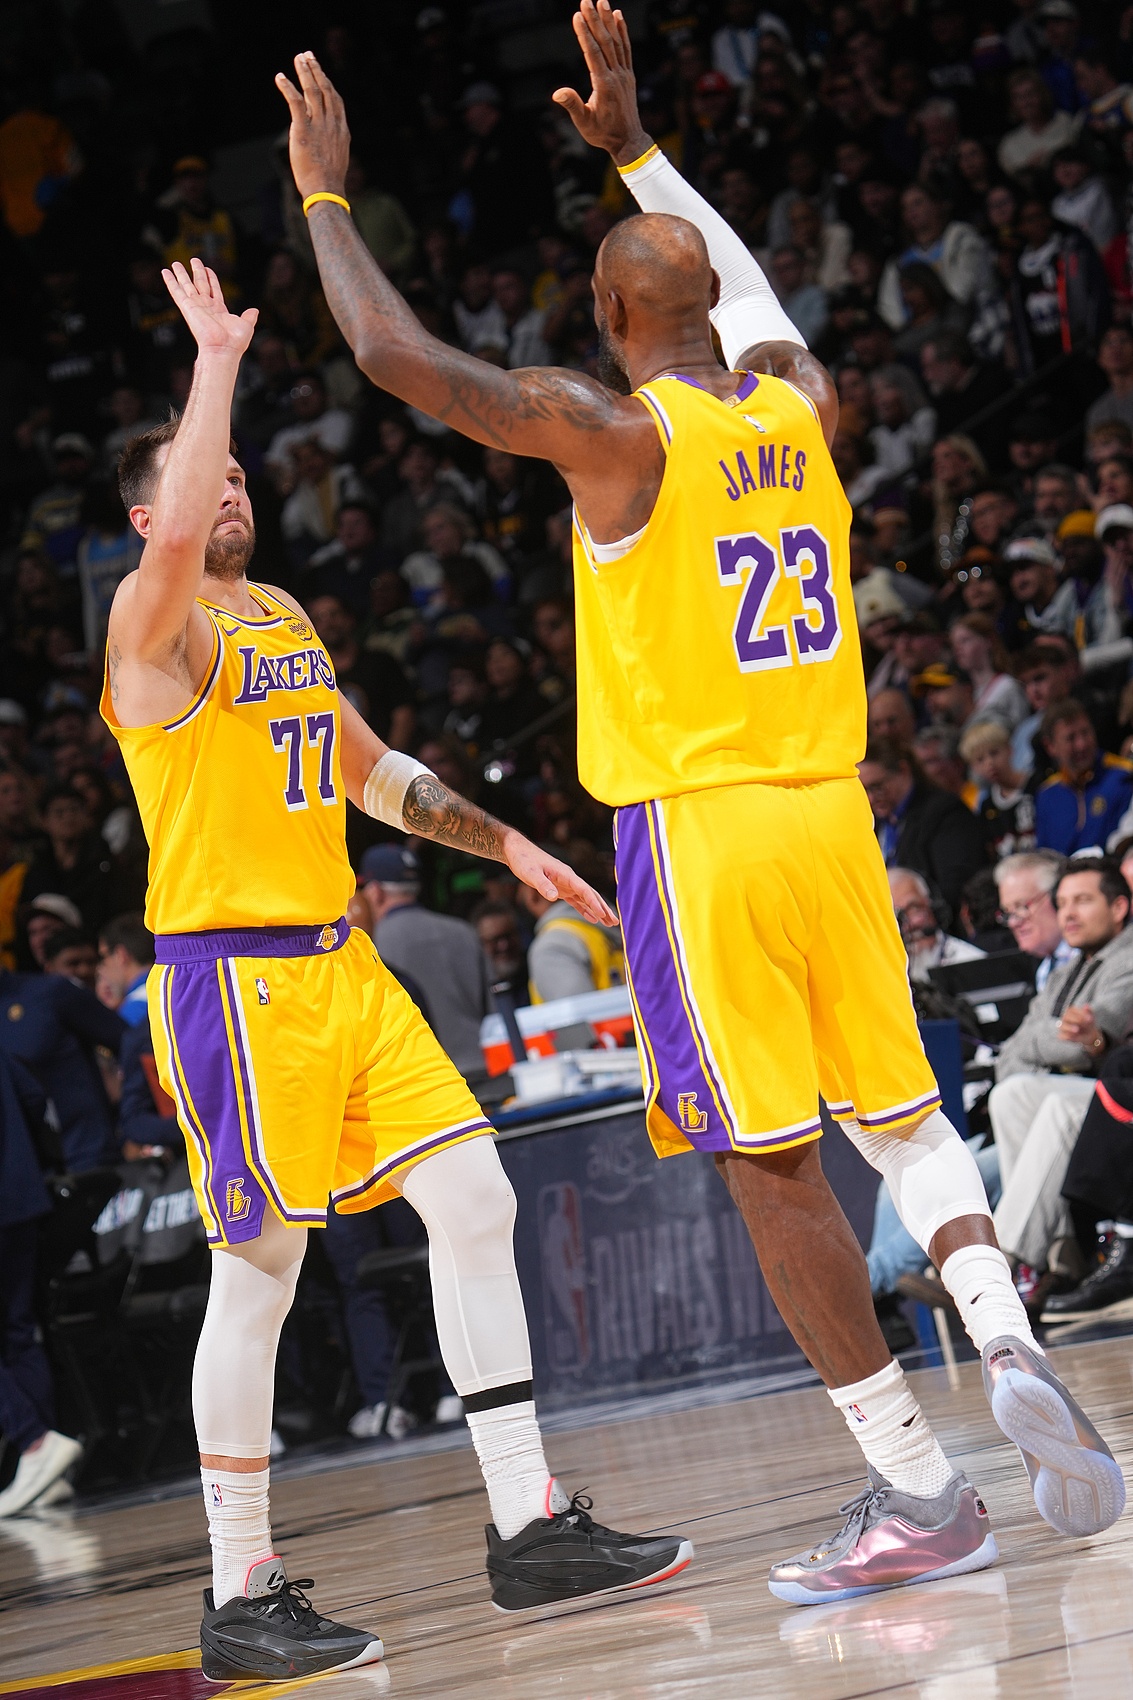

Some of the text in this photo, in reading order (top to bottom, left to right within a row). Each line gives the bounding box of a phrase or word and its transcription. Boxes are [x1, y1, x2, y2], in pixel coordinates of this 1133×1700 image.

[719, 444, 806, 501] JAMES
[714, 524, 843, 674] 23
[233, 645, 337, 706] LAKERS
[267, 710, 338, 812] 77
[591, 1216, 722, 1362] RIVALS
